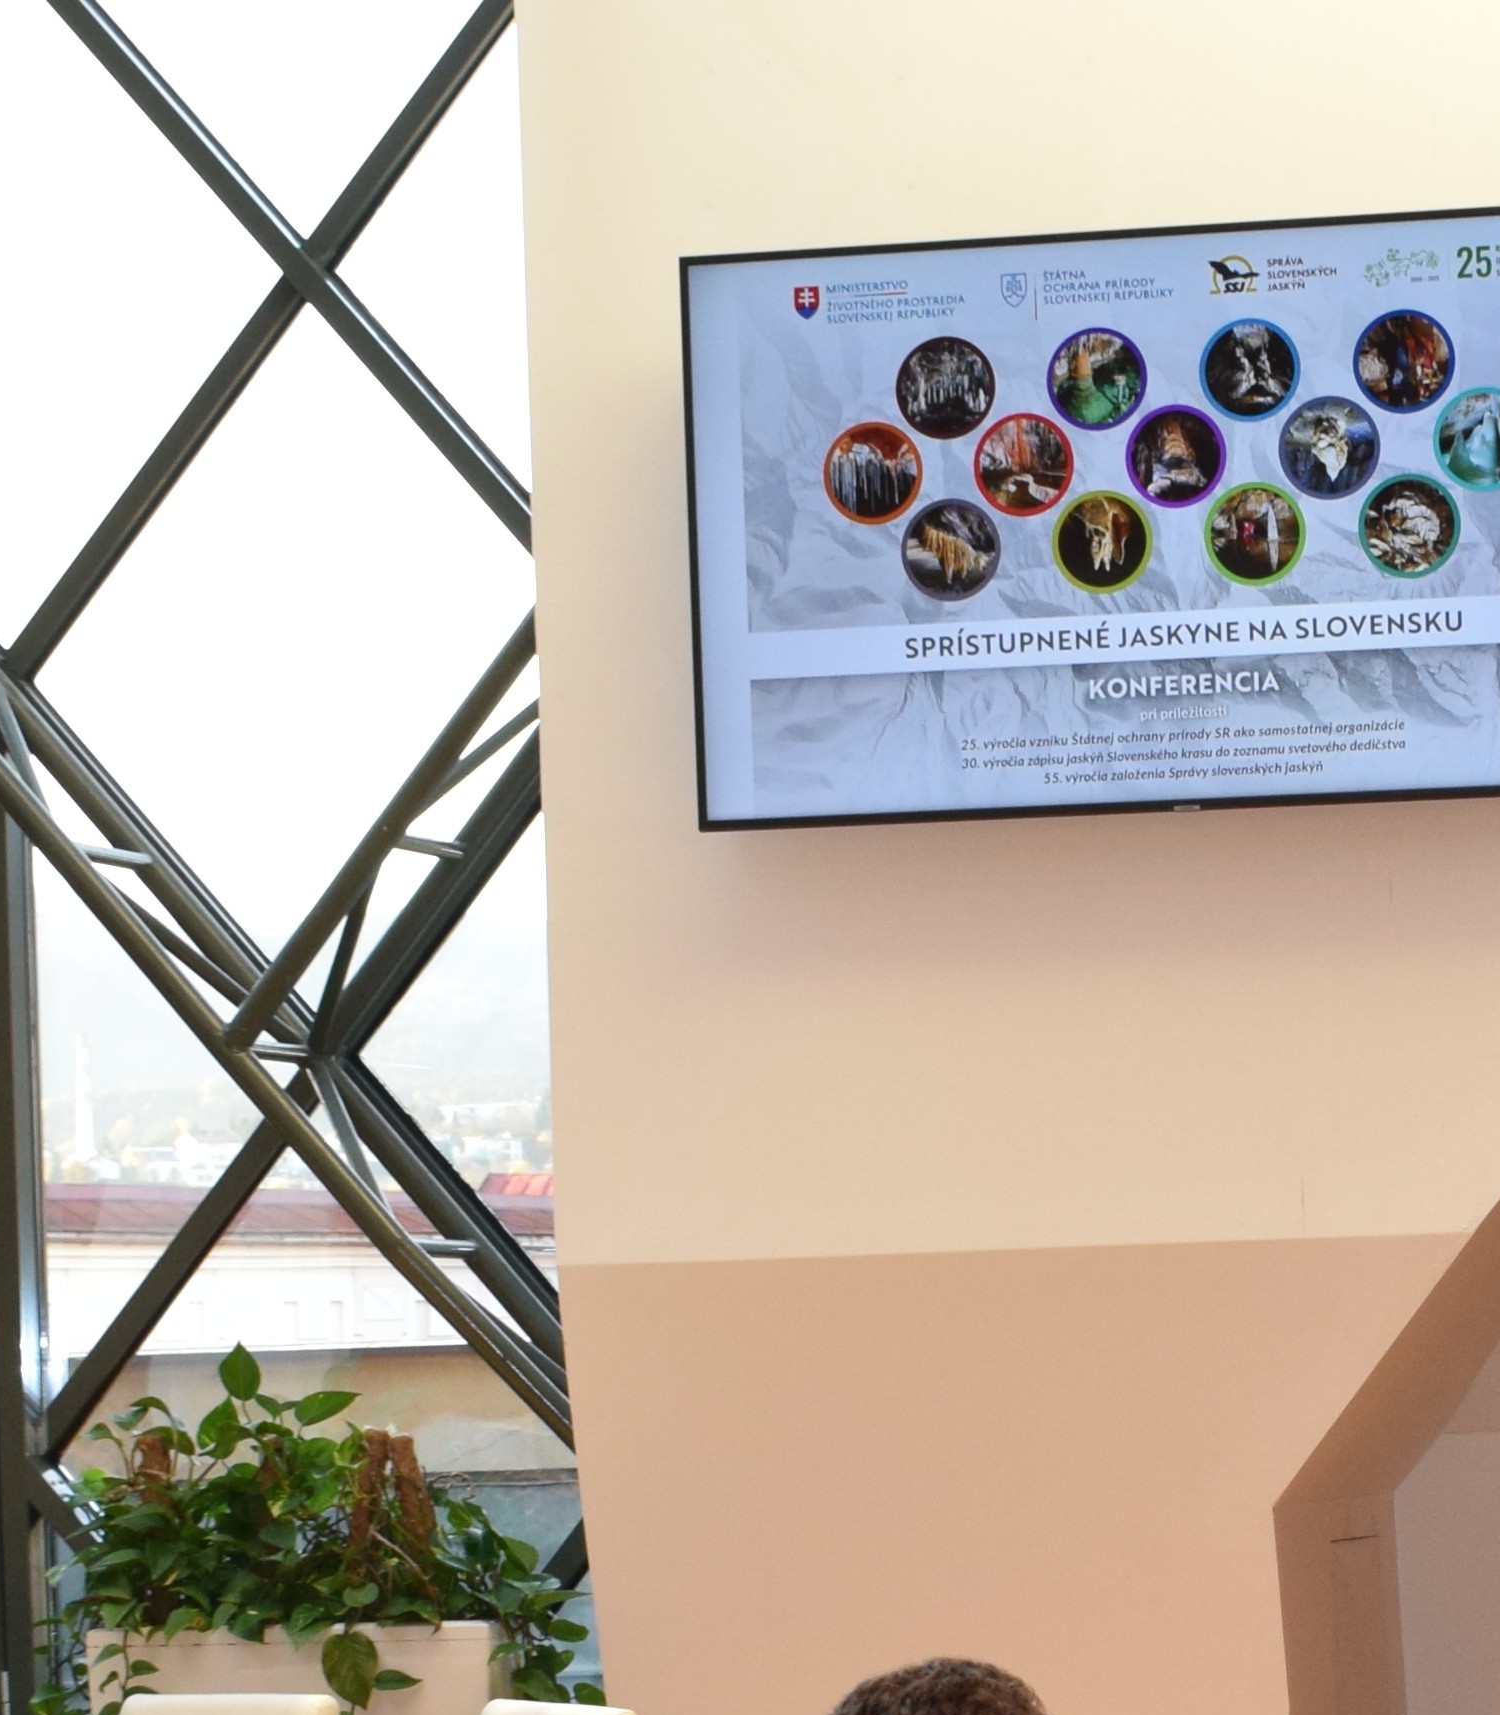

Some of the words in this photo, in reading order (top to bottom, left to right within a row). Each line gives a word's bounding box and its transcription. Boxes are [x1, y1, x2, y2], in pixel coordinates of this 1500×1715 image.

[1267, 256, 1304, 267] SPRÁVA
[1456, 246, 1492, 279] 25
[1043, 270, 1086, 282] ŠTÁTNA
[1267, 266, 1337, 280] SLOVENSKÝCH
[826, 280, 908, 294] MINISTERSTVO
[1043, 282, 1101, 293] OCHRANA
[1105, 278, 1155, 289] PRÍRODY
[1223, 281, 1245, 294] SSJ
[1267, 279, 1306, 292] JASKÝŇ
[827, 299, 894, 313] ŽIVOTNÉHO
[897, 295, 965, 308] PROSTREDIA
[1043, 292, 1110, 305] SLOVENSKEJ
[1114, 288, 1174, 300] REPUBLIKY
[827, 311, 893, 324] SLOVENSKEJ
[897, 308, 955, 320] REPUBLIKY
[904, 621, 1111, 659] SPRÍSTUPNENÉ
[1118, 617, 1241, 648] JASKYNE
[1249, 614, 1288, 643] NA
[1295, 610, 1465, 641] SLOVENSKU
[1088, 670, 1280, 700] KONFERENCIA
[1140, 708, 1157, 722] pri
[1161, 704, 1228, 721] príležitosti
[961, 739, 980, 751] 25.
[983, 736, 1026, 750] výročia
[1029, 735, 1068, 747] vzniku
[1072, 732, 1115, 746] Štátnej
[1117, 729, 1165, 744] ochrany
[1168, 726, 1211, 741] prírody
[1214, 727, 1230, 739] SR
[1233, 726, 1255, 738] ako
[1259, 721, 1333, 737] samostatnej
[1336, 718, 1405, 734] organizácie
[961, 758, 980, 769] 30.
[983, 755, 1025, 770] výročia
[1028, 753, 1064, 768] zápisu
[1066, 750, 1104, 767] jaskýň
[1106, 748, 1178, 763] Slovenského
[1181, 747, 1213, 759] krasu
[1215, 745, 1230, 758] do
[1233, 746, 1285, 757] zoznamu
[1288, 740, 1347, 754] svetového
[1349, 738, 1406, 751] dedičstva
[1044, 772, 1063, 784] 55.
[1065, 769, 1108, 784] výročia
[1111, 767, 1165, 781] založenia
[1169, 764, 1208, 779] Správy
[1211, 761, 1282, 776] slovenských
[1284, 759, 1323, 775] jaskýň
